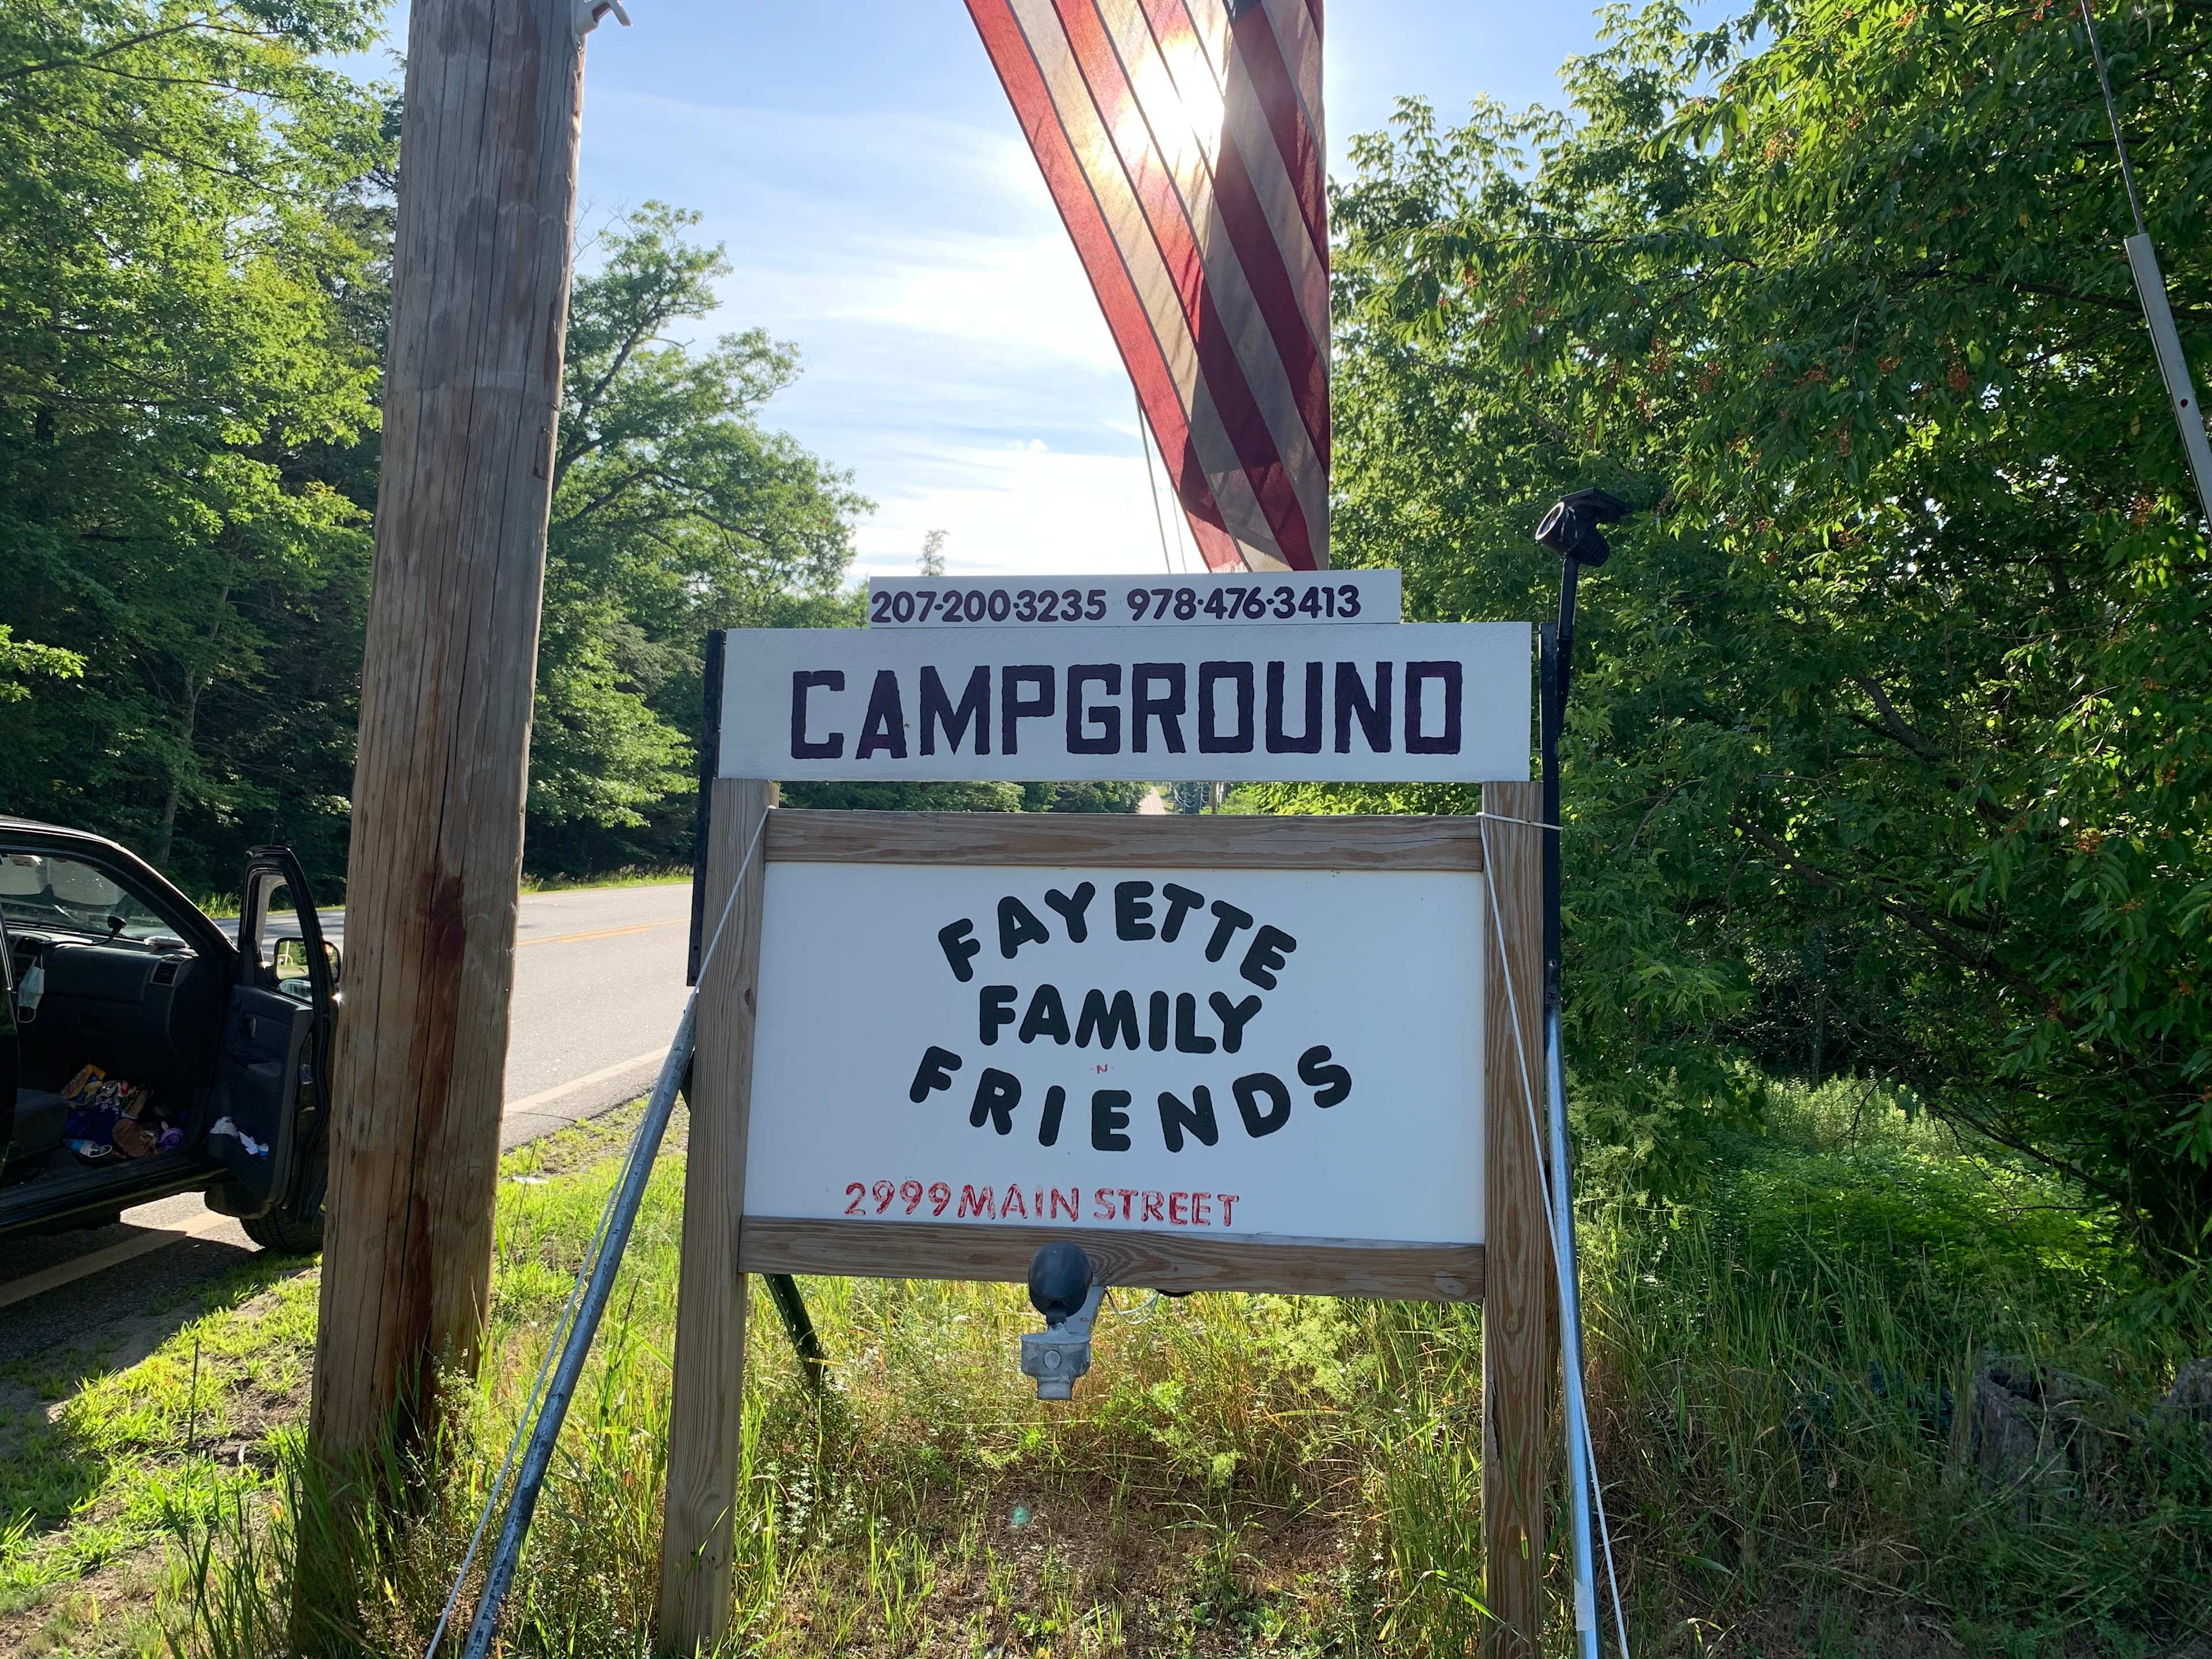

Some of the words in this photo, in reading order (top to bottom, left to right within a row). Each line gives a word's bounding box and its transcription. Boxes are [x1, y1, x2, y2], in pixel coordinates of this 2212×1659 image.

[790, 660, 1463, 760] CAMPGROUND
[938, 881, 1297, 991] FAYETTE
[979, 983, 1263, 1054] FAMILY
[909, 1045, 1353, 1153] FRIENDS
[1093, 1188, 1240, 1226] STREET
